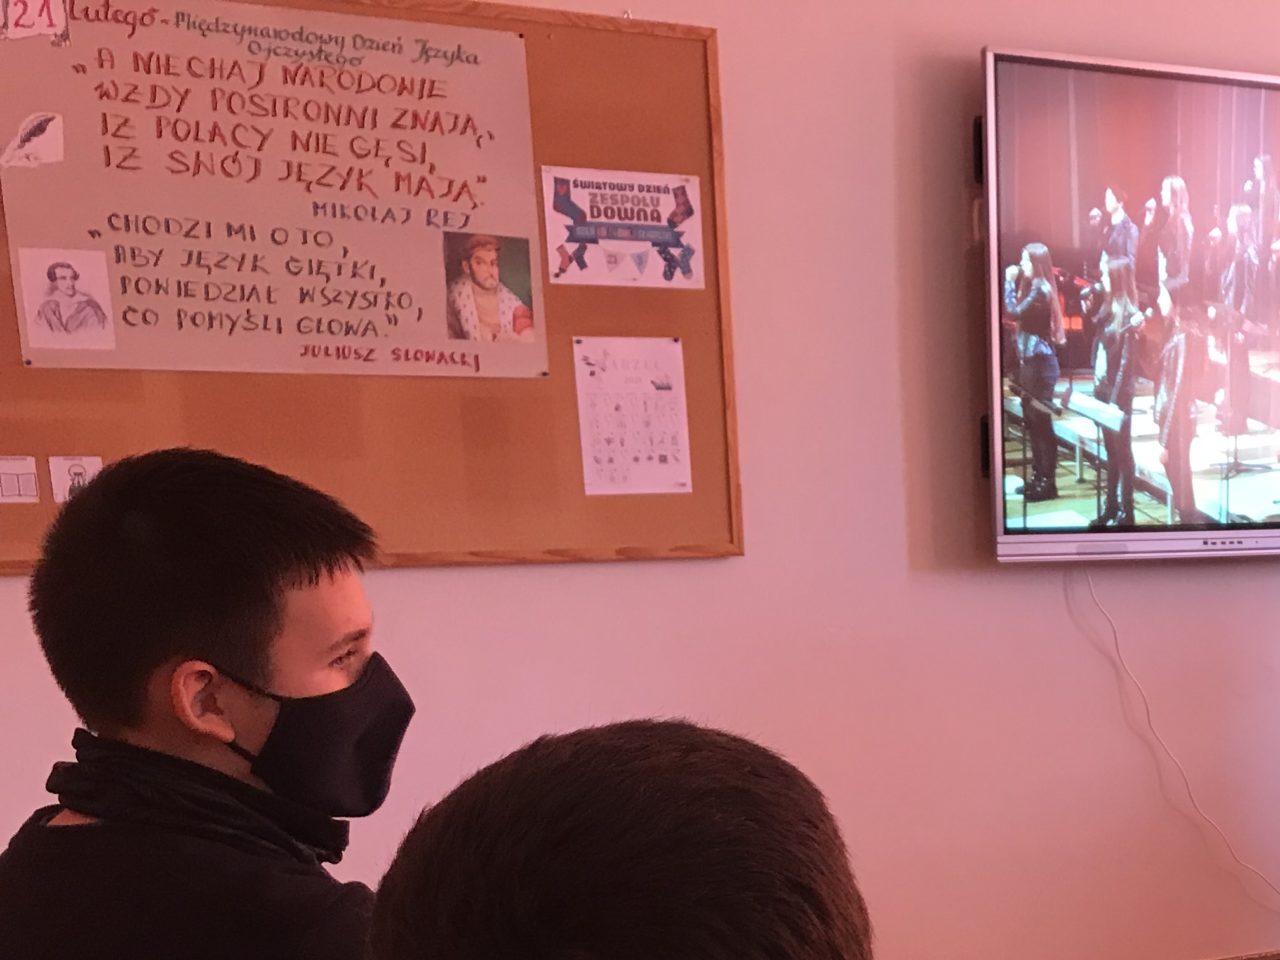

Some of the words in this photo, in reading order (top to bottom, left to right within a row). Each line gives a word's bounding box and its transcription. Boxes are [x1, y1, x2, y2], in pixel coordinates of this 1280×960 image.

[14, 0, 58, 30] 21
[132, 51, 267, 90] NIECHAJ
[211, 87, 378, 129] POSTRONNI
[156, 115, 274, 151] POLACY
[291, 130, 339, 157] NIE
[278, 160, 379, 199] JĘZYK
[426, 208, 471, 229] REJ
[589, 204, 662, 224] DOWNA
[226, 222, 256, 242] MI
[114, 245, 165, 267] ABY
[181, 251, 270, 275] JĘZYK
[122, 305, 160, 328] CO
[300, 344, 377, 363] JULIUSZ
